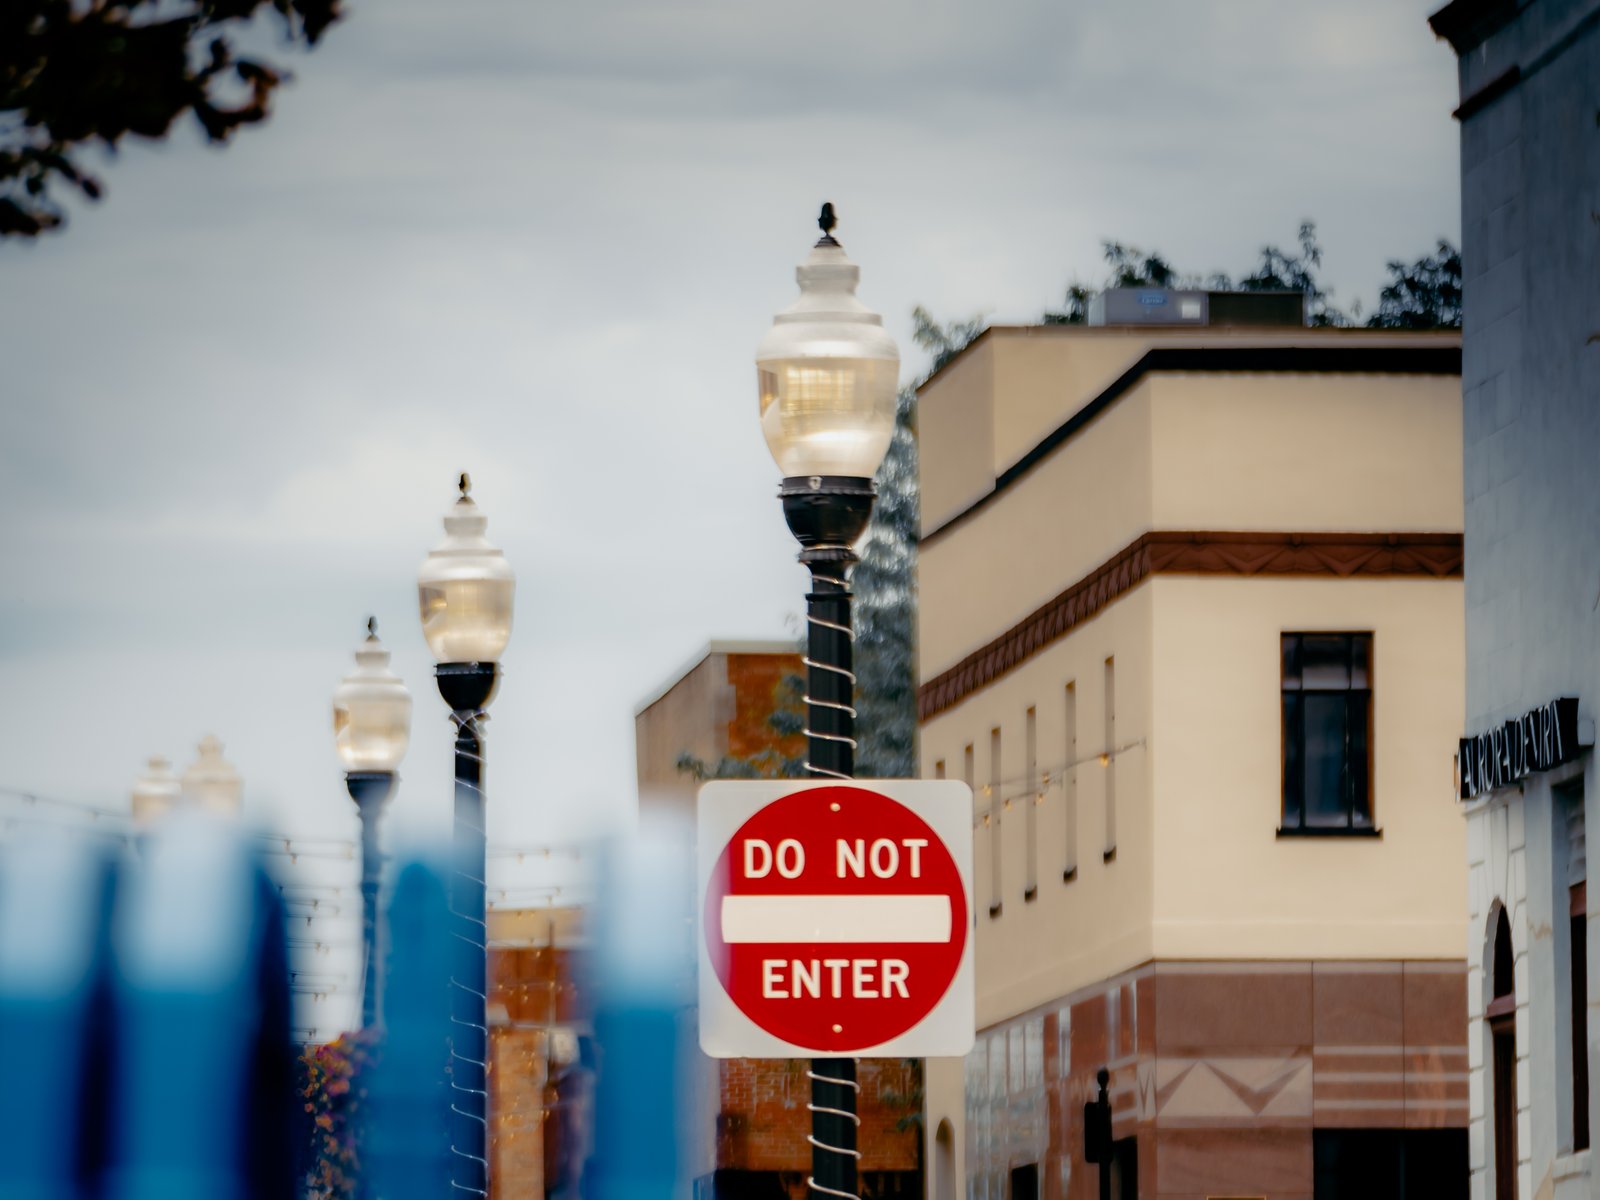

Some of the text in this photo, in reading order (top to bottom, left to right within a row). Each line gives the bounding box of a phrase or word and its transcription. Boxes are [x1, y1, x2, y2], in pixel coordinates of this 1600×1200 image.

[743, 838, 929, 879] DO NOT
[762, 959, 910, 999] ENTER
